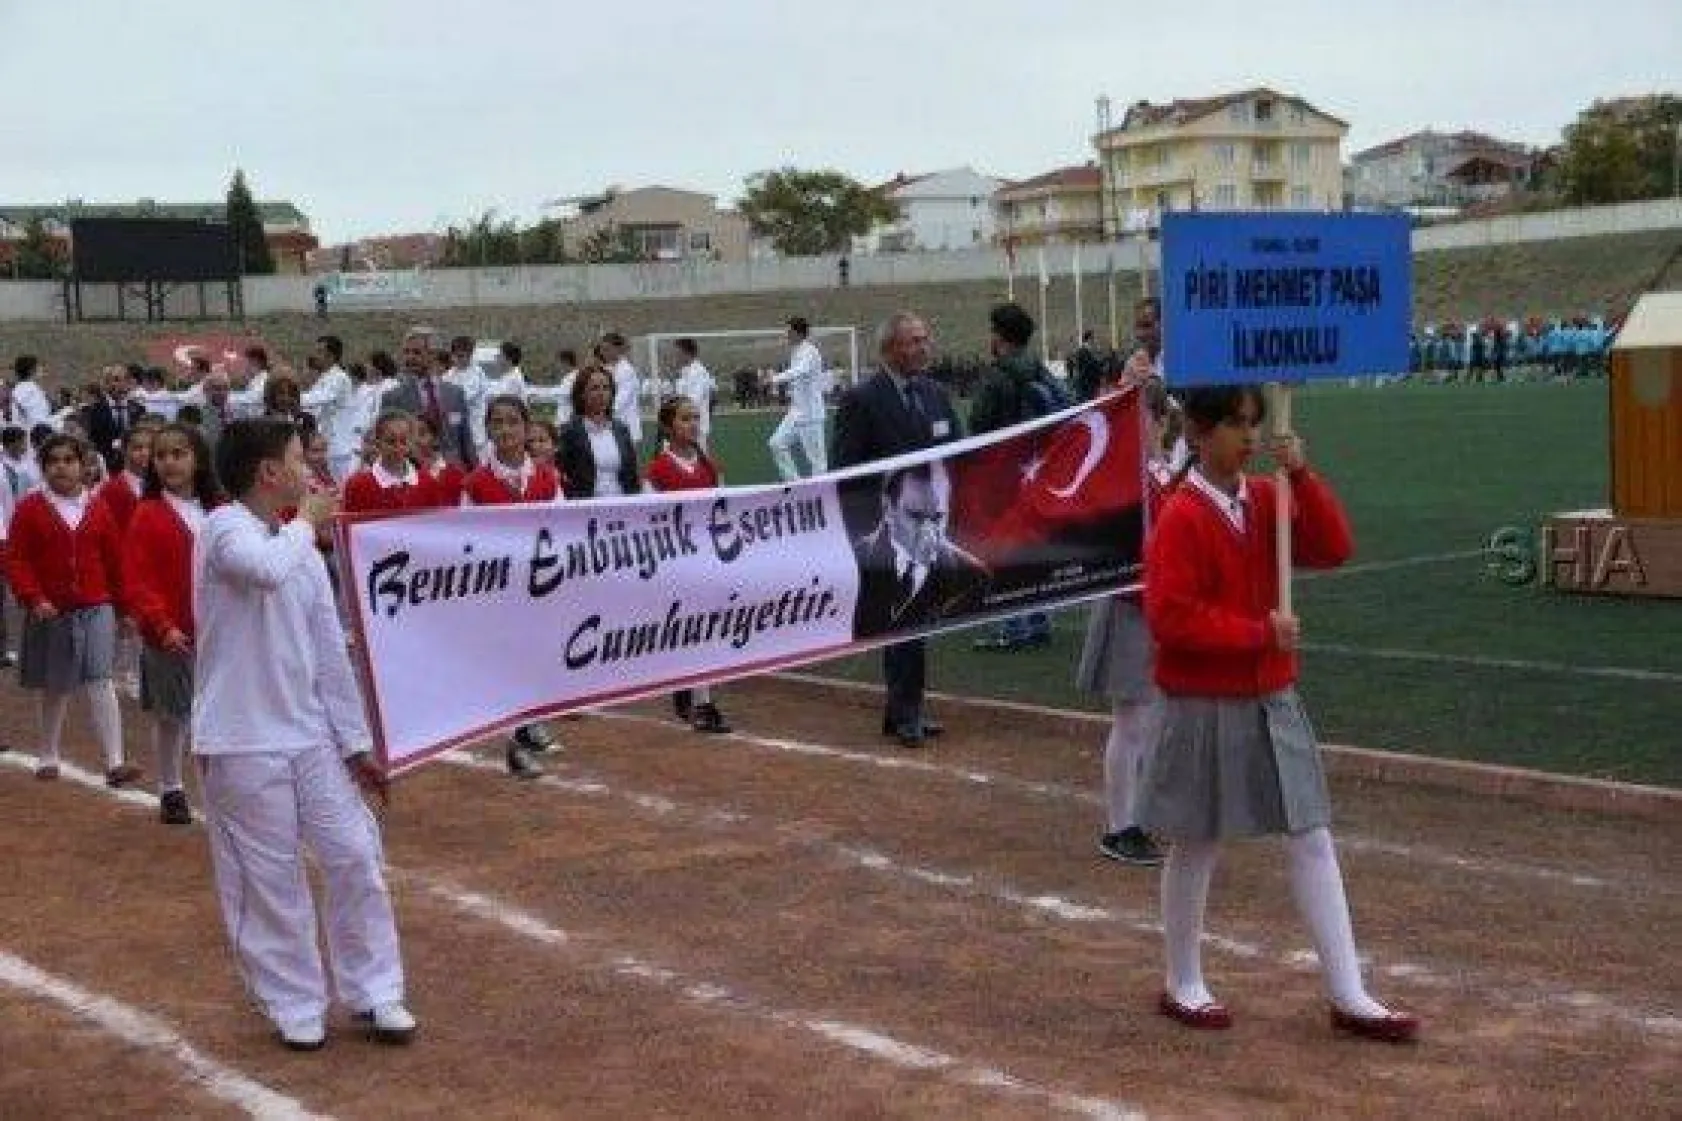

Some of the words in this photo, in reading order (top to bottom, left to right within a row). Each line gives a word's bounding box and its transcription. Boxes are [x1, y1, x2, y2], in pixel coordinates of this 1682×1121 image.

[1235, 268, 1326, 308] MEHMET
[1231, 322, 1341, 367] İLKOKULU
[367, 544, 511, 616] Benim
[529, 510, 699, 597] Enbüyük
[707, 487, 828, 564] Eserim
[564, 575, 838, 670] Cumhuriyettir.
